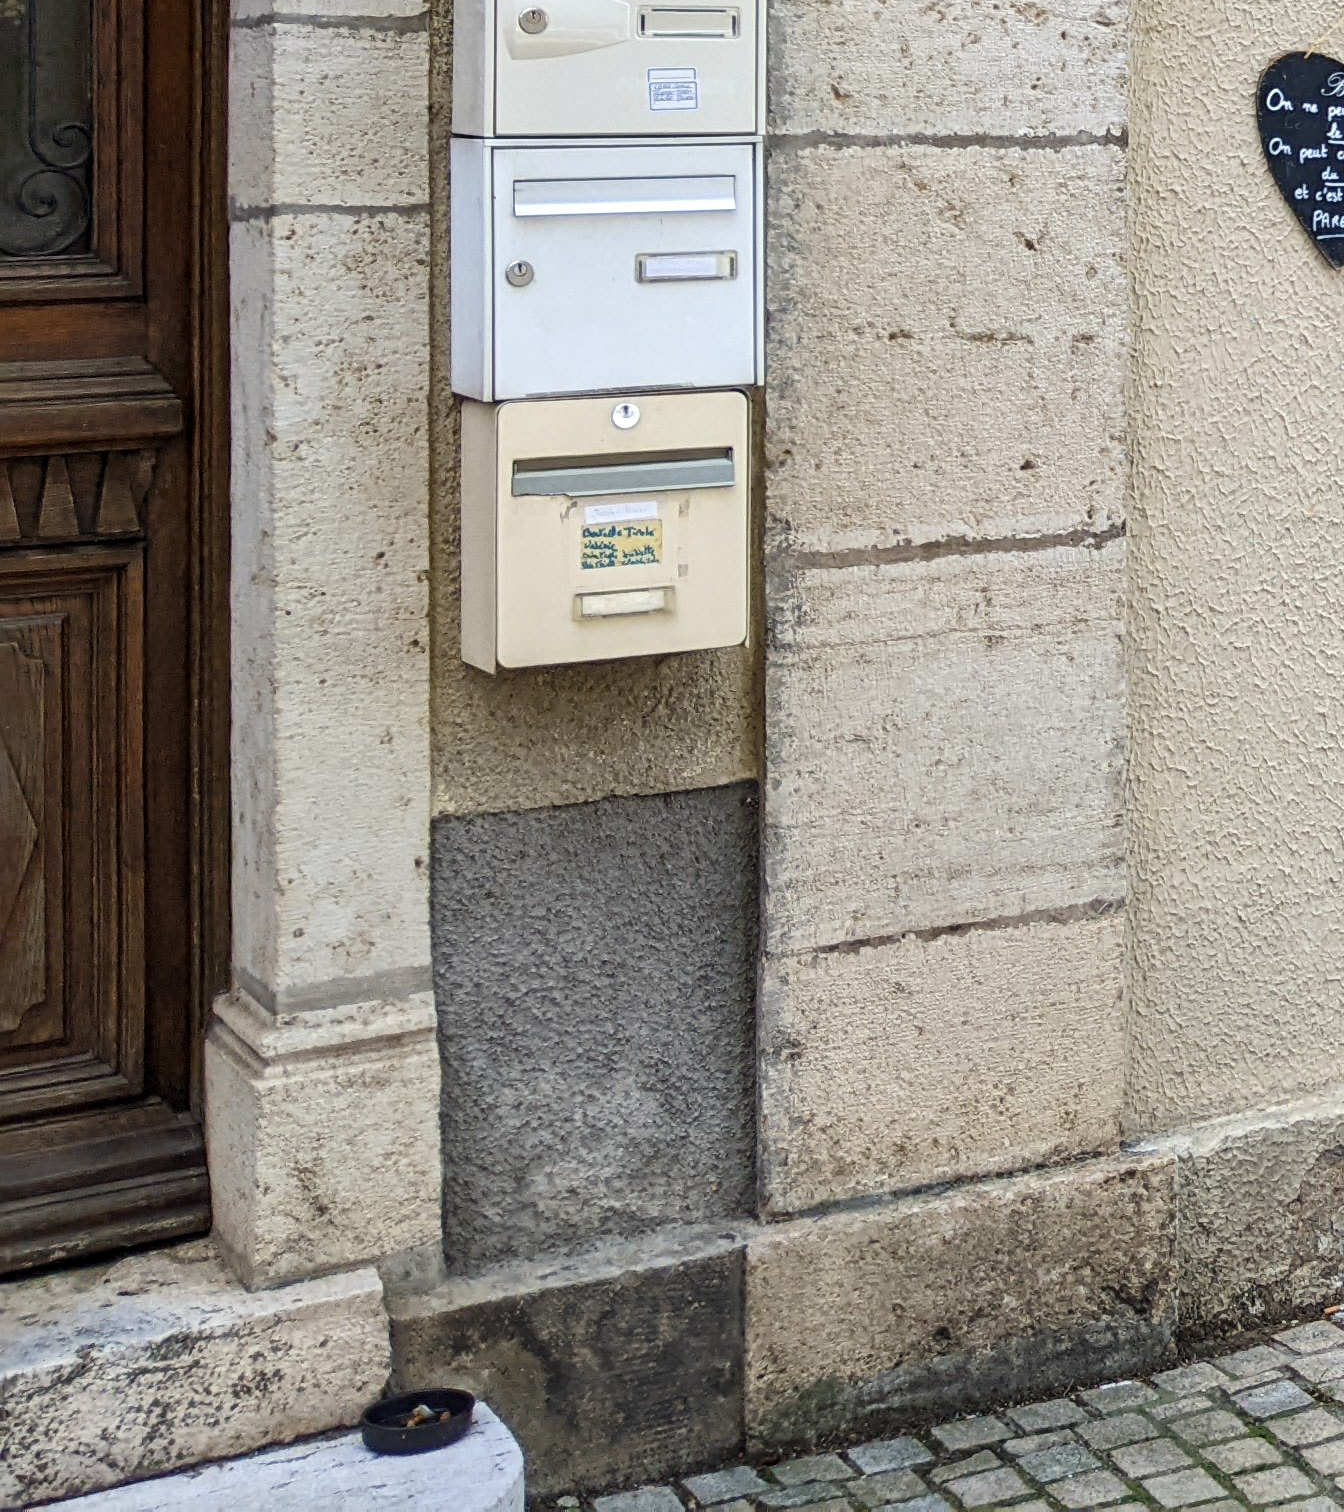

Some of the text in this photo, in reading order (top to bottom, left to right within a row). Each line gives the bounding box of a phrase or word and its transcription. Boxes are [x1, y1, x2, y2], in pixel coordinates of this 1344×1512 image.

[1266, 88, 1293, 111] On
[1302, 102, 1318, 113] ne
[1269, 138, 1291, 155] On
[1300, 144, 1328, 163] peut
[1322, 166, 1339, 181] du
[1295, 184, 1309, 199] et
[1316, 187, 1343, 202] c'est
